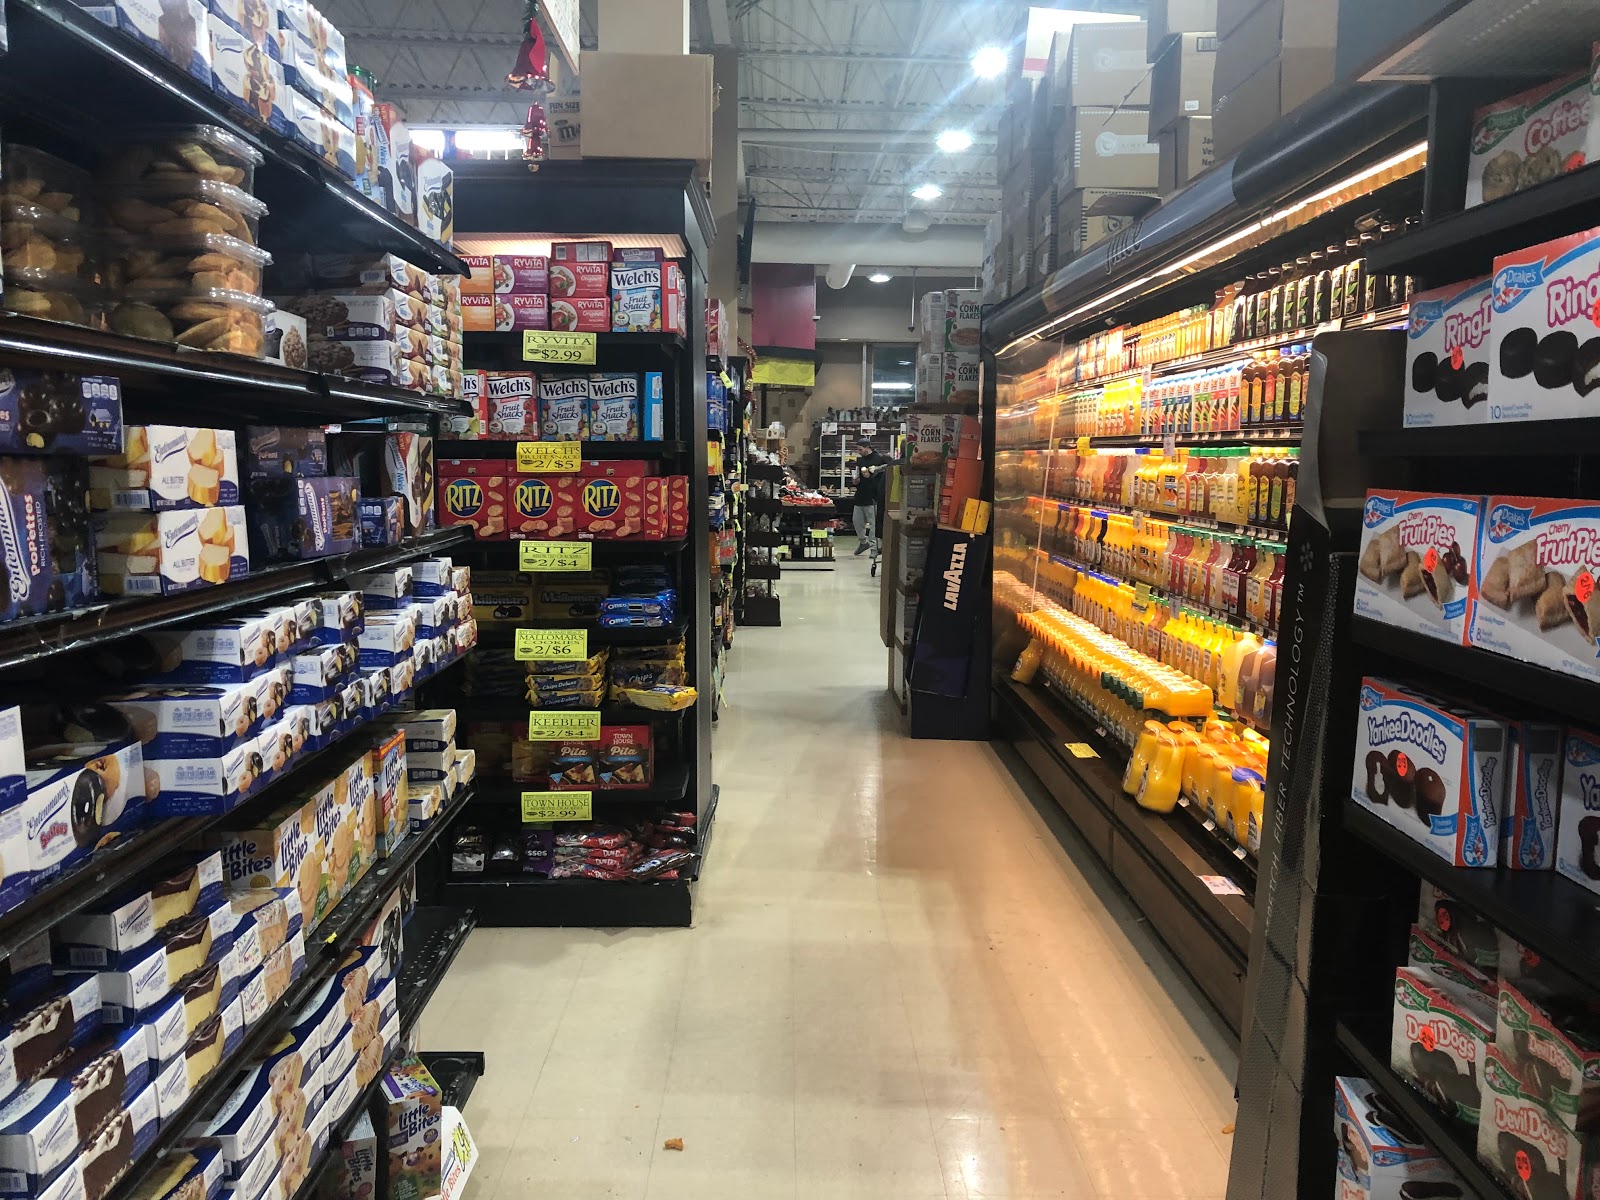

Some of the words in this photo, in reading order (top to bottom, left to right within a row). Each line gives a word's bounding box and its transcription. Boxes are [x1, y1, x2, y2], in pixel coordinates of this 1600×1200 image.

[614, 270, 659, 286] Welch's
[1506, 268, 1537, 285] Drake's
[628, 295, 648, 304] Fruit
[623, 302, 652, 310] Snacks
[960, 304, 980, 313] CORN
[527, 336, 592, 345] RYVITA
[541, 350, 582, 361] $2.99
[959, 366, 978, 375] CORN
[488, 380, 531, 395] Welch's
[543, 381, 587, 397] Welch's
[592, 381, 636, 397] Welch's
[497, 410, 524, 419] Snacks
[551, 411, 580, 419] Snacks
[600, 411, 629, 419] Snacks
[920, 428, 941, 436] CORN
[920, 435, 941, 443] FLAKES
[535, 460, 574, 469] 2/$5
[447, 484, 481, 512] RITZ
[516, 484, 550, 513] RITZ
[585, 485, 618, 513] RITZ
[1549, 523, 1572, 535] Cherry
[524, 546, 588, 554] RITZ
[538, 559, 578, 567] 2/$4
[943, 542, 968, 611] LAVAZZA
[473, 593, 528, 606] allomars
[535, 645, 571, 655] 2/$6
[629, 673, 653, 683] Chips
[533, 718, 597, 726] KEEBLER
[561, 746, 588, 756] Pita
[611, 746, 637, 756] Pita
[349, 764, 363, 808] Little
[355, 779, 369, 816] Bites
[526, 799, 555, 807] TOWN
[557, 799, 589, 807] HOUSE
[316, 792, 334, 838] Little
[324, 809, 341, 848] Bites
[281, 821, 300, 872] Little
[221, 840, 257, 866] ittle
[289, 838, 308, 881] Bites
[229, 855, 273, 881] Bites
[399, 1103, 430, 1131] Little
[409, 1112, 440, 1138] Bites
